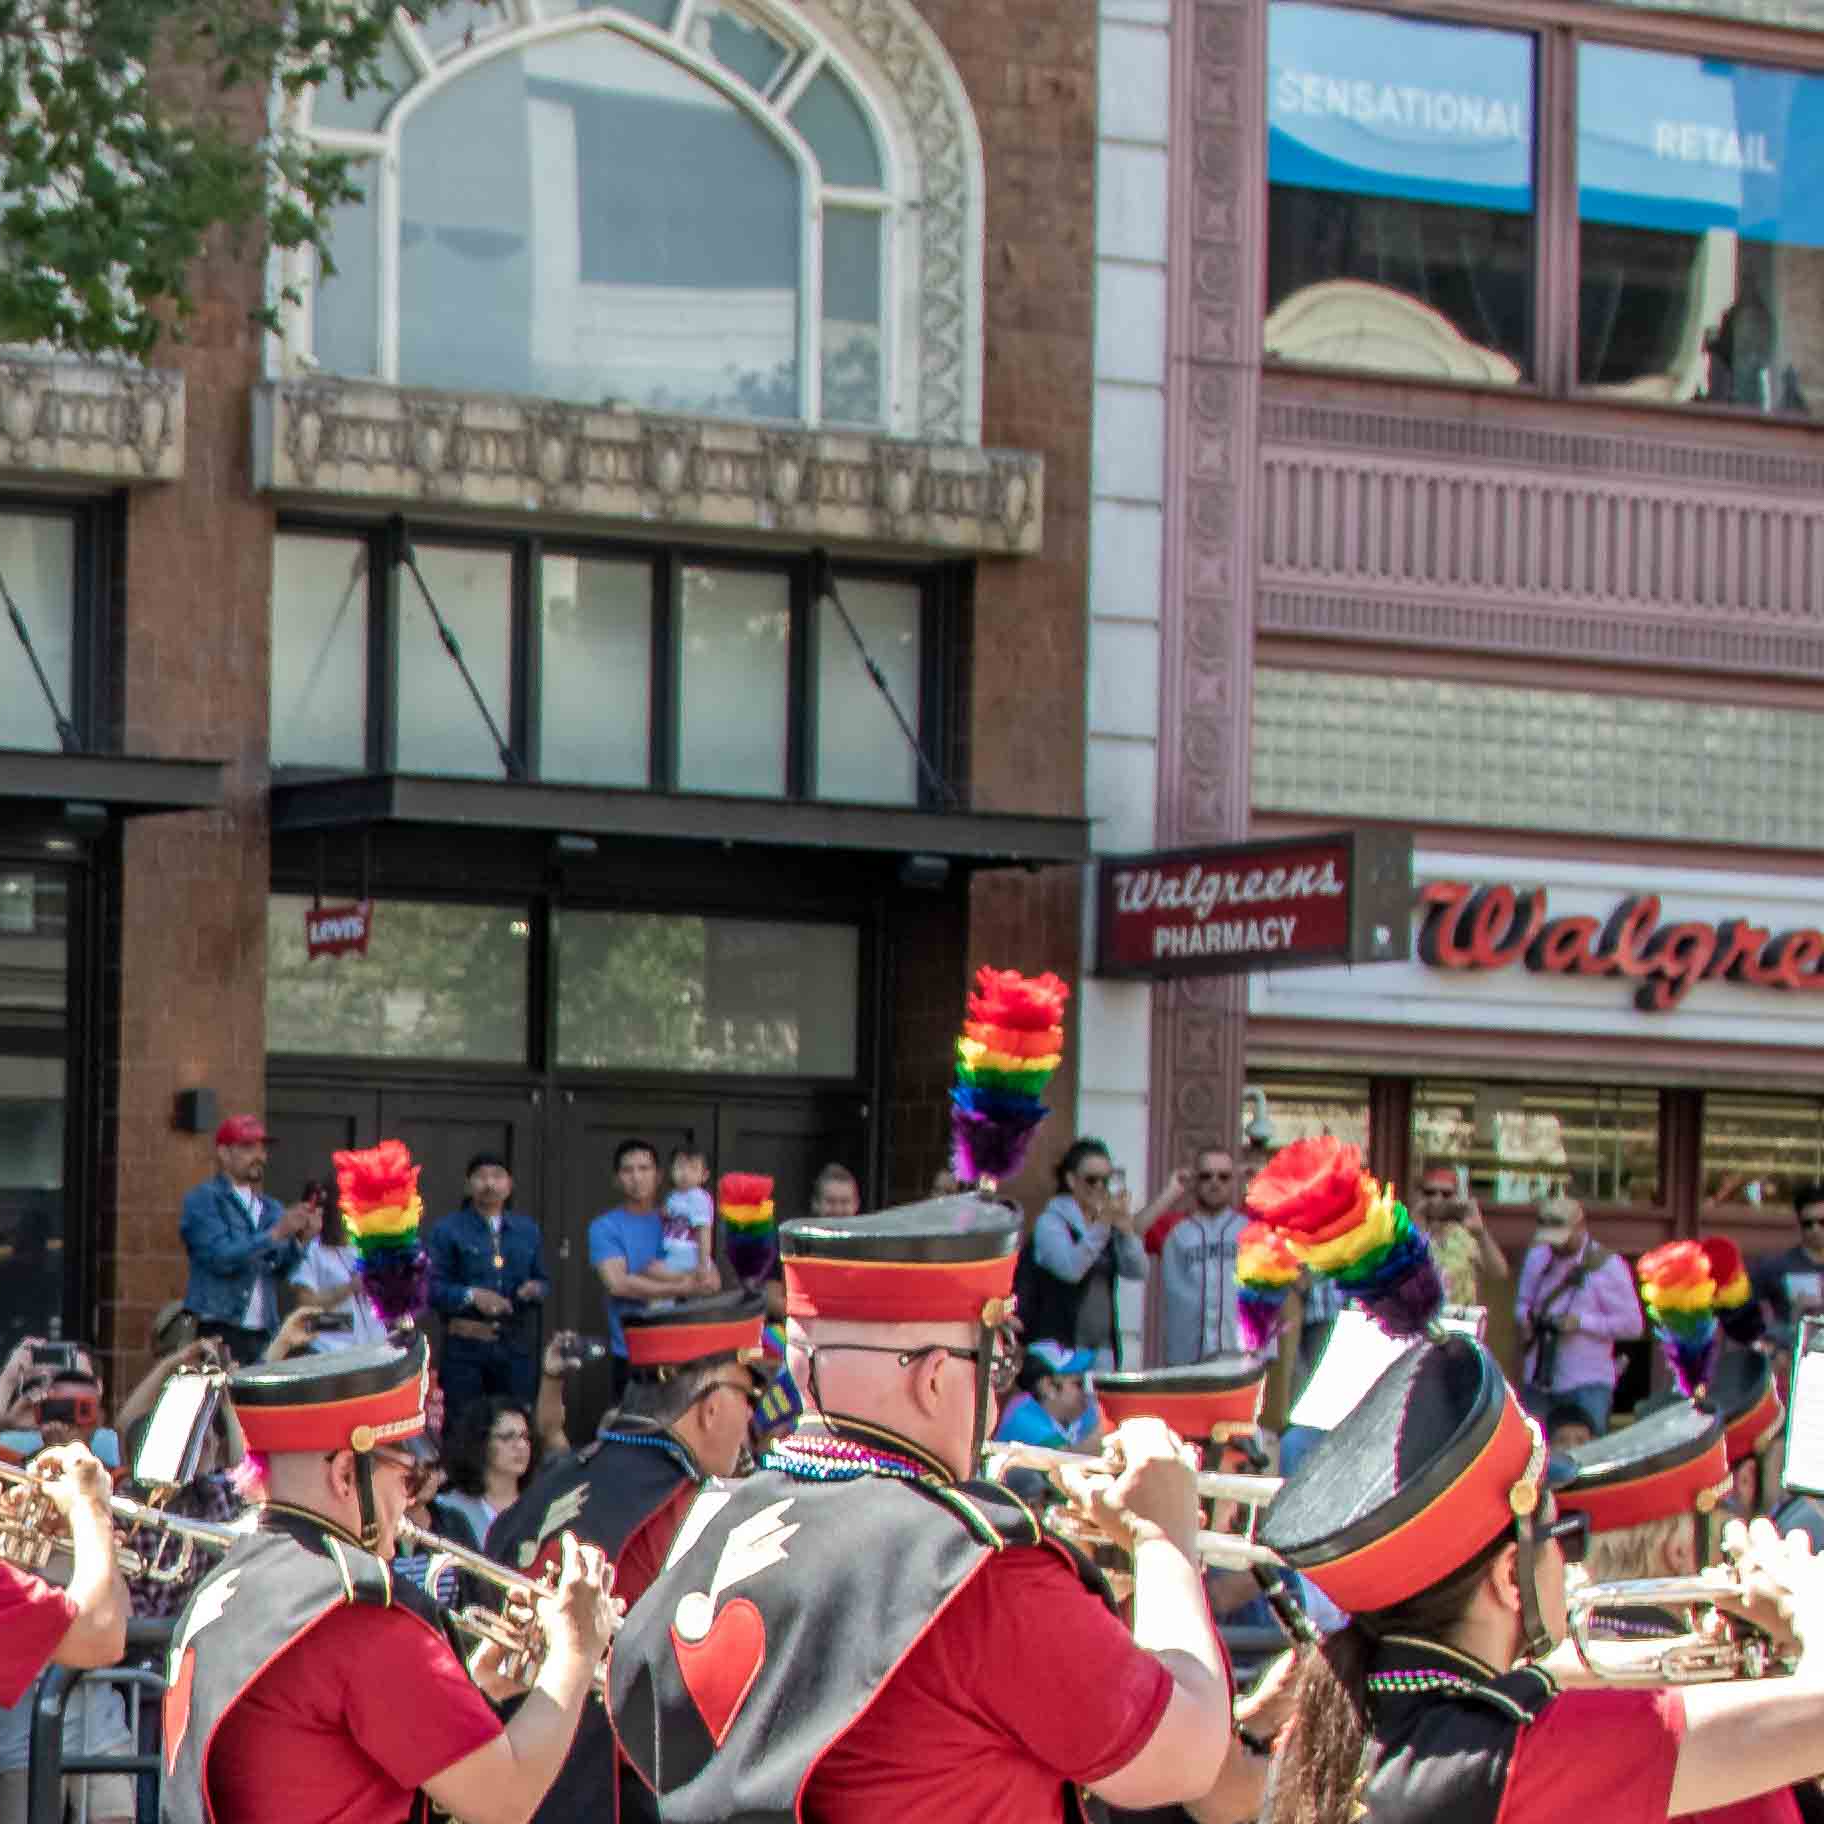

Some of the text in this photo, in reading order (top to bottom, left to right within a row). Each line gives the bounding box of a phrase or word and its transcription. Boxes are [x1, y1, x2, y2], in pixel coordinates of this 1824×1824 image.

[1276, 67, 1778, 173] SENSATIONAL RETAIL
[1113, 858, 1345, 920] Walgreens
[1155, 915, 1297, 959] PHARMACY
